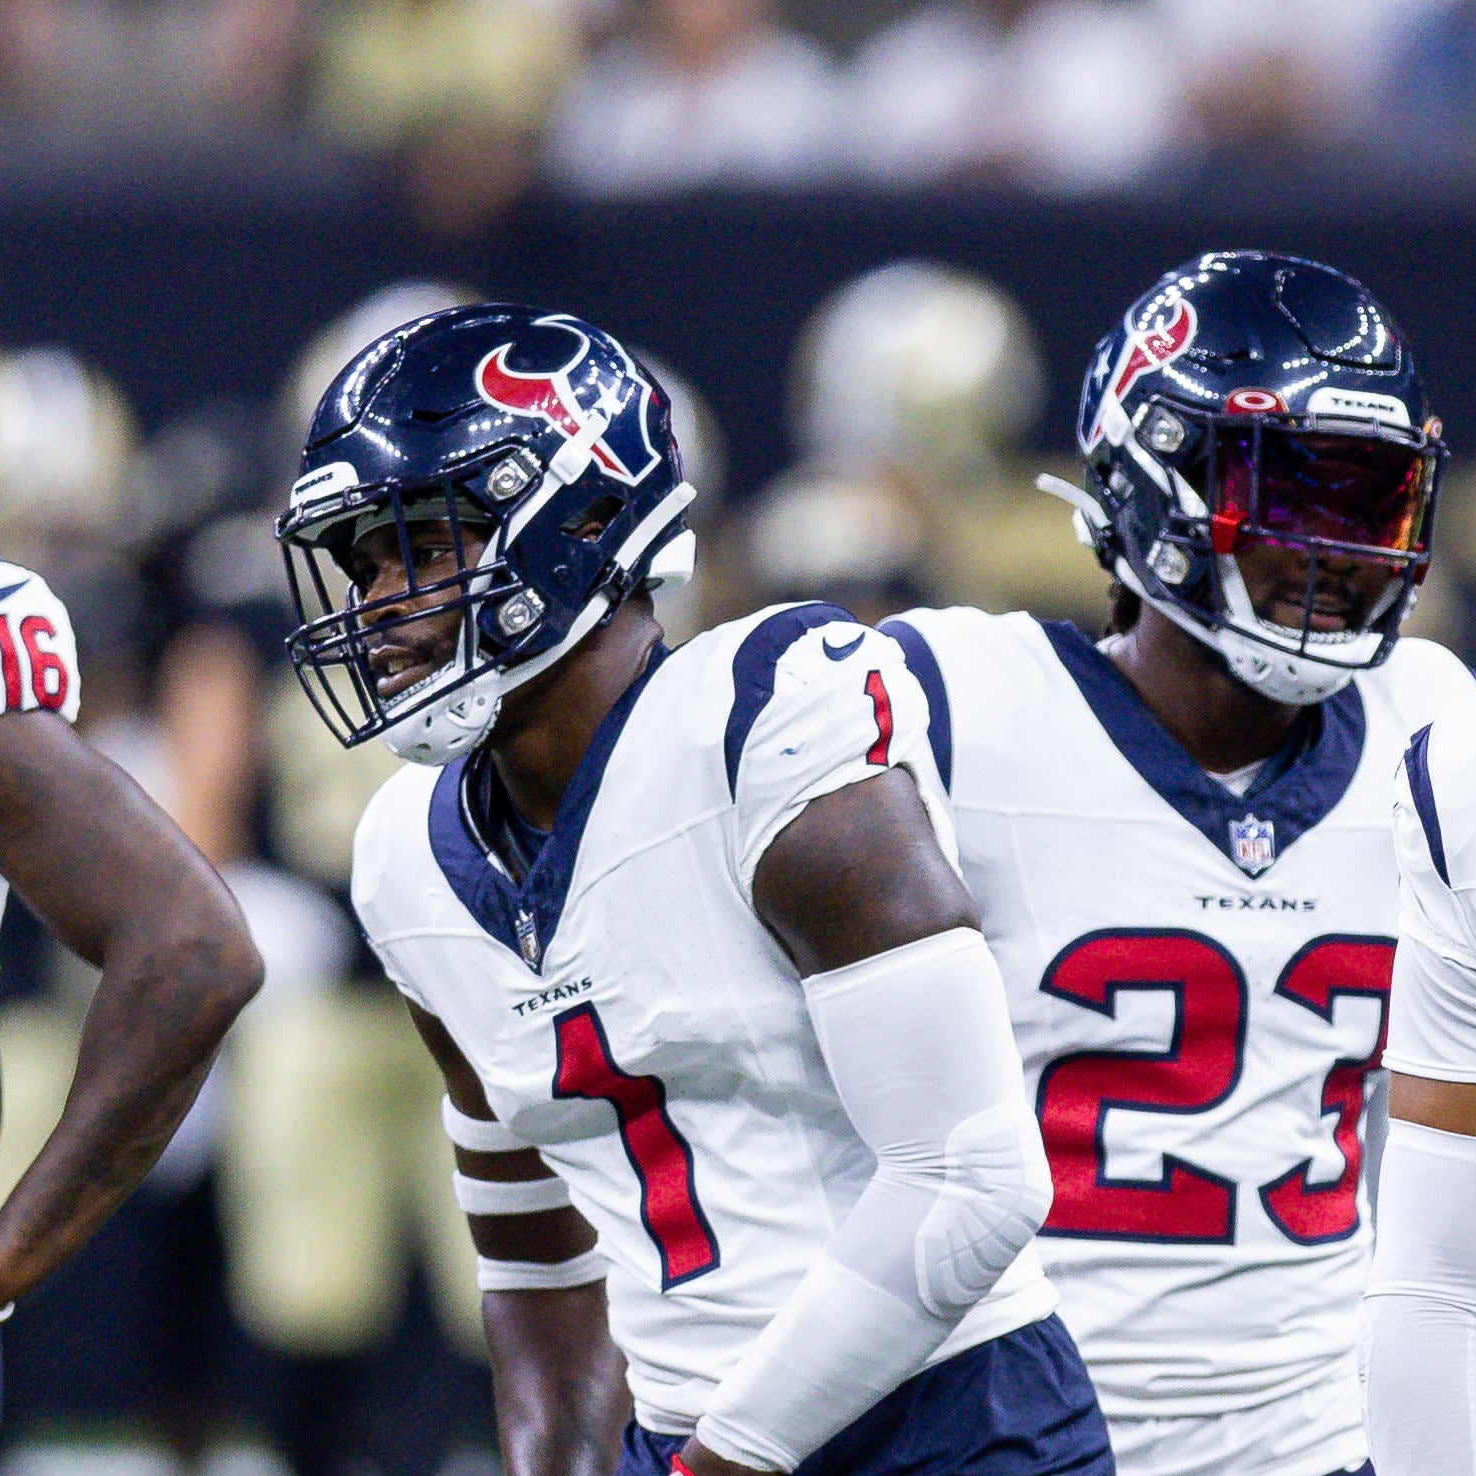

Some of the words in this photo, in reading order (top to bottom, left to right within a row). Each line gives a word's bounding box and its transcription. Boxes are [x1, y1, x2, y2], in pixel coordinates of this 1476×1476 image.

[863, 669, 894, 768] 1
[1194, 895, 1319, 911] TEXANS
[512, 976, 593, 1017] TEXANS
[1035, 925, 1399, 1248] 23
[551, 999, 722, 1294] 1
